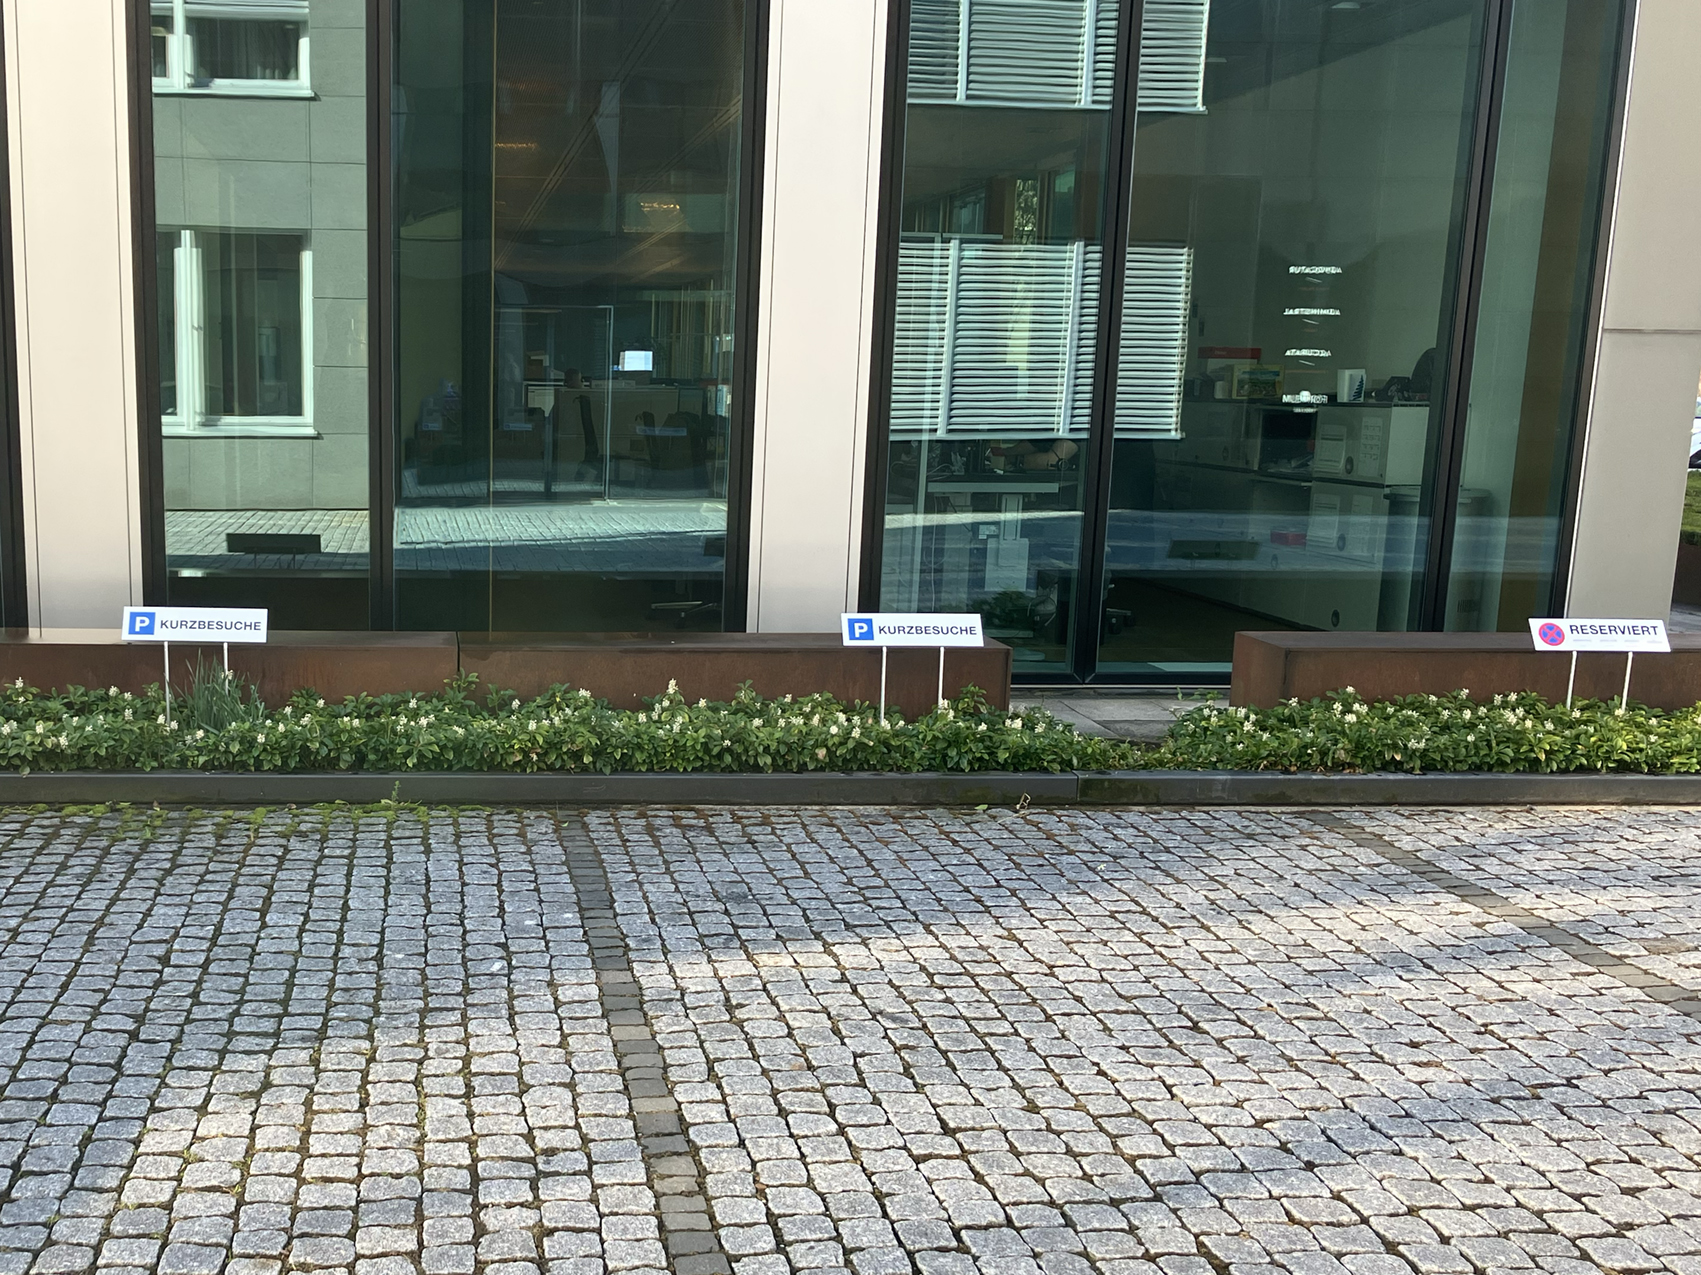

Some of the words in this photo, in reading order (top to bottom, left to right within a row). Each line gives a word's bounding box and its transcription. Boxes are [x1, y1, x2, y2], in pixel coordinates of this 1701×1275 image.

[134, 616, 150, 632] P
[160, 619, 262, 631] KURZBESUCHE
[854, 622, 868, 638] P
[878, 625, 977, 636] KURZBESUCHE
[1569, 624, 1659, 636] RESERVIERT
